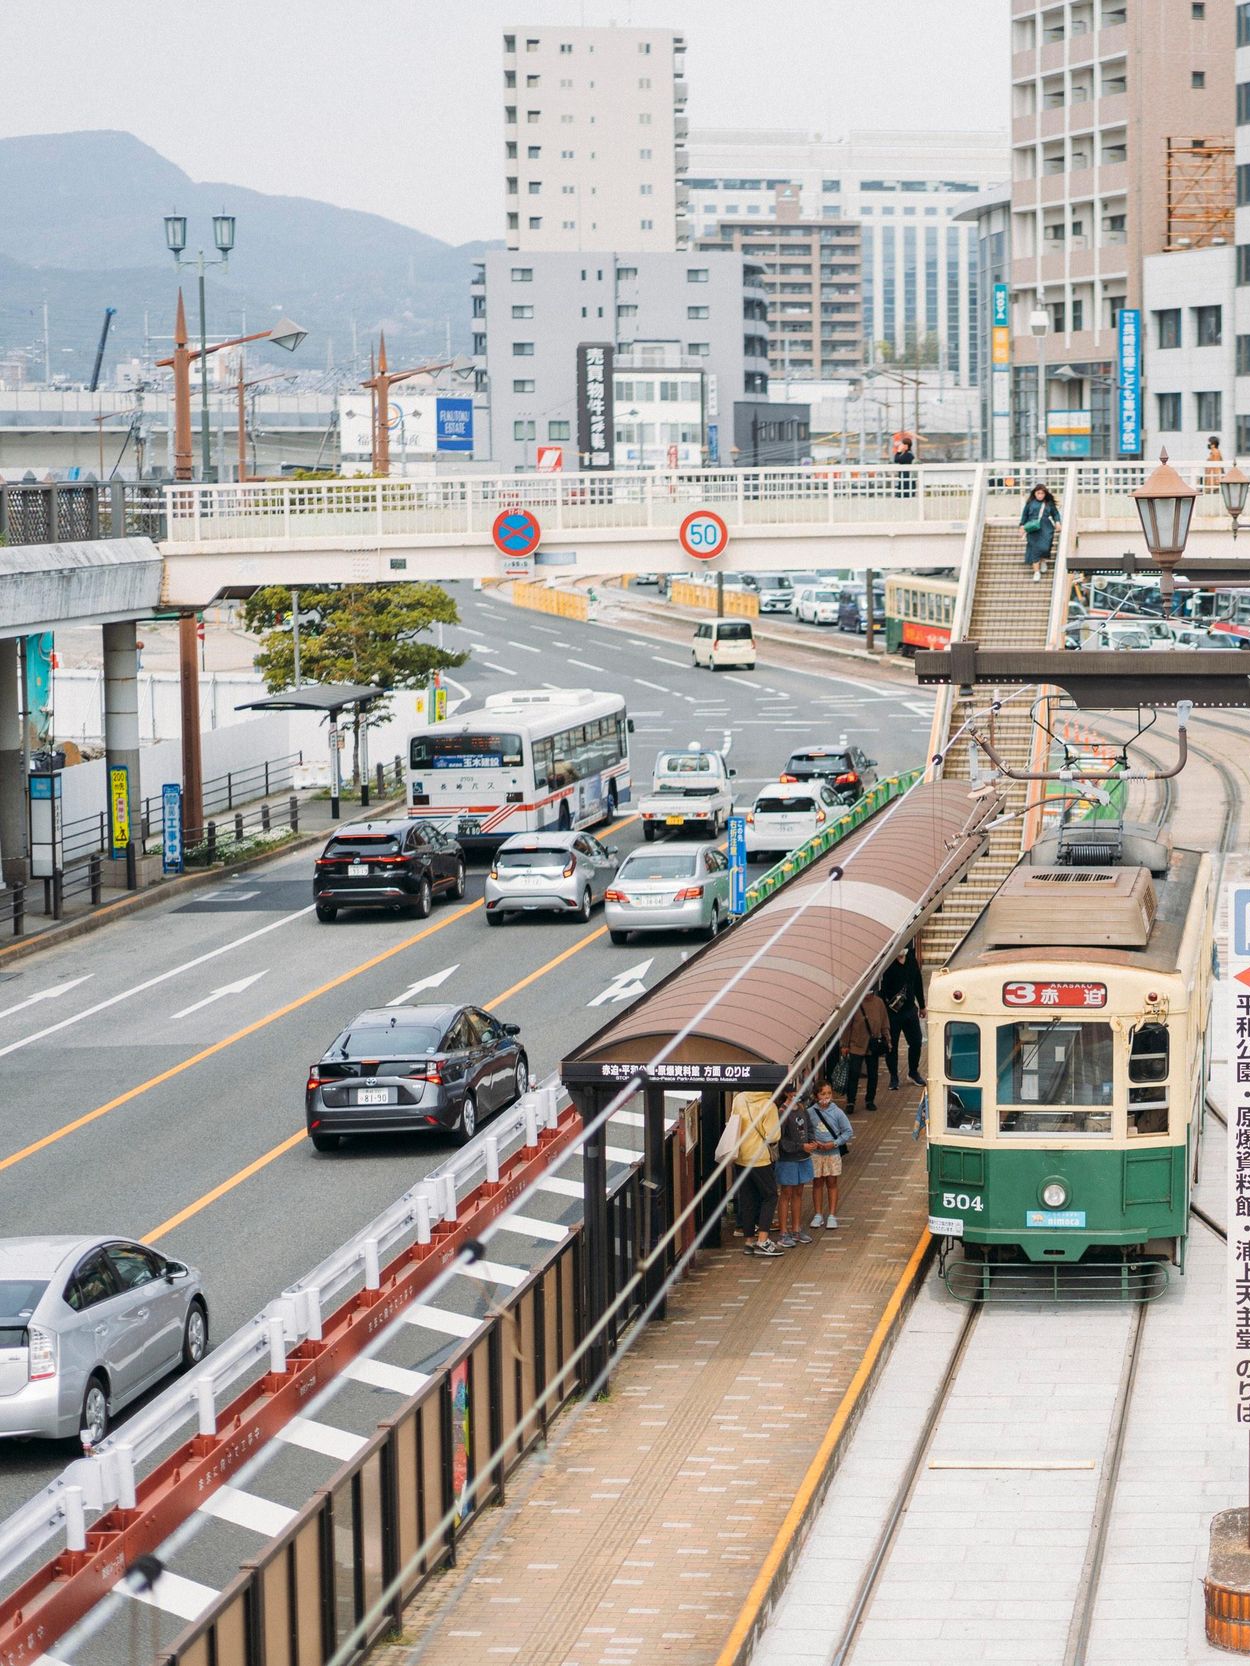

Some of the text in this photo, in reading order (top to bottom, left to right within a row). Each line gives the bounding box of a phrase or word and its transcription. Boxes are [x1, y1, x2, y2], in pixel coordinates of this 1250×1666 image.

[690, 524, 717, 545] 50
[463, 757, 500, 768] 玉木建設
[113, 772, 125, 782] 200
[1005, 983, 1036, 1004] 3
[1041, 989, 1104, 1005] 赤迫
[703, 1065, 721, 1077] 方面
[725, 1066, 751, 1077] のりば
[364, 1094, 387, 1103] 81-90
[942, 1193, 984, 1212] 504
